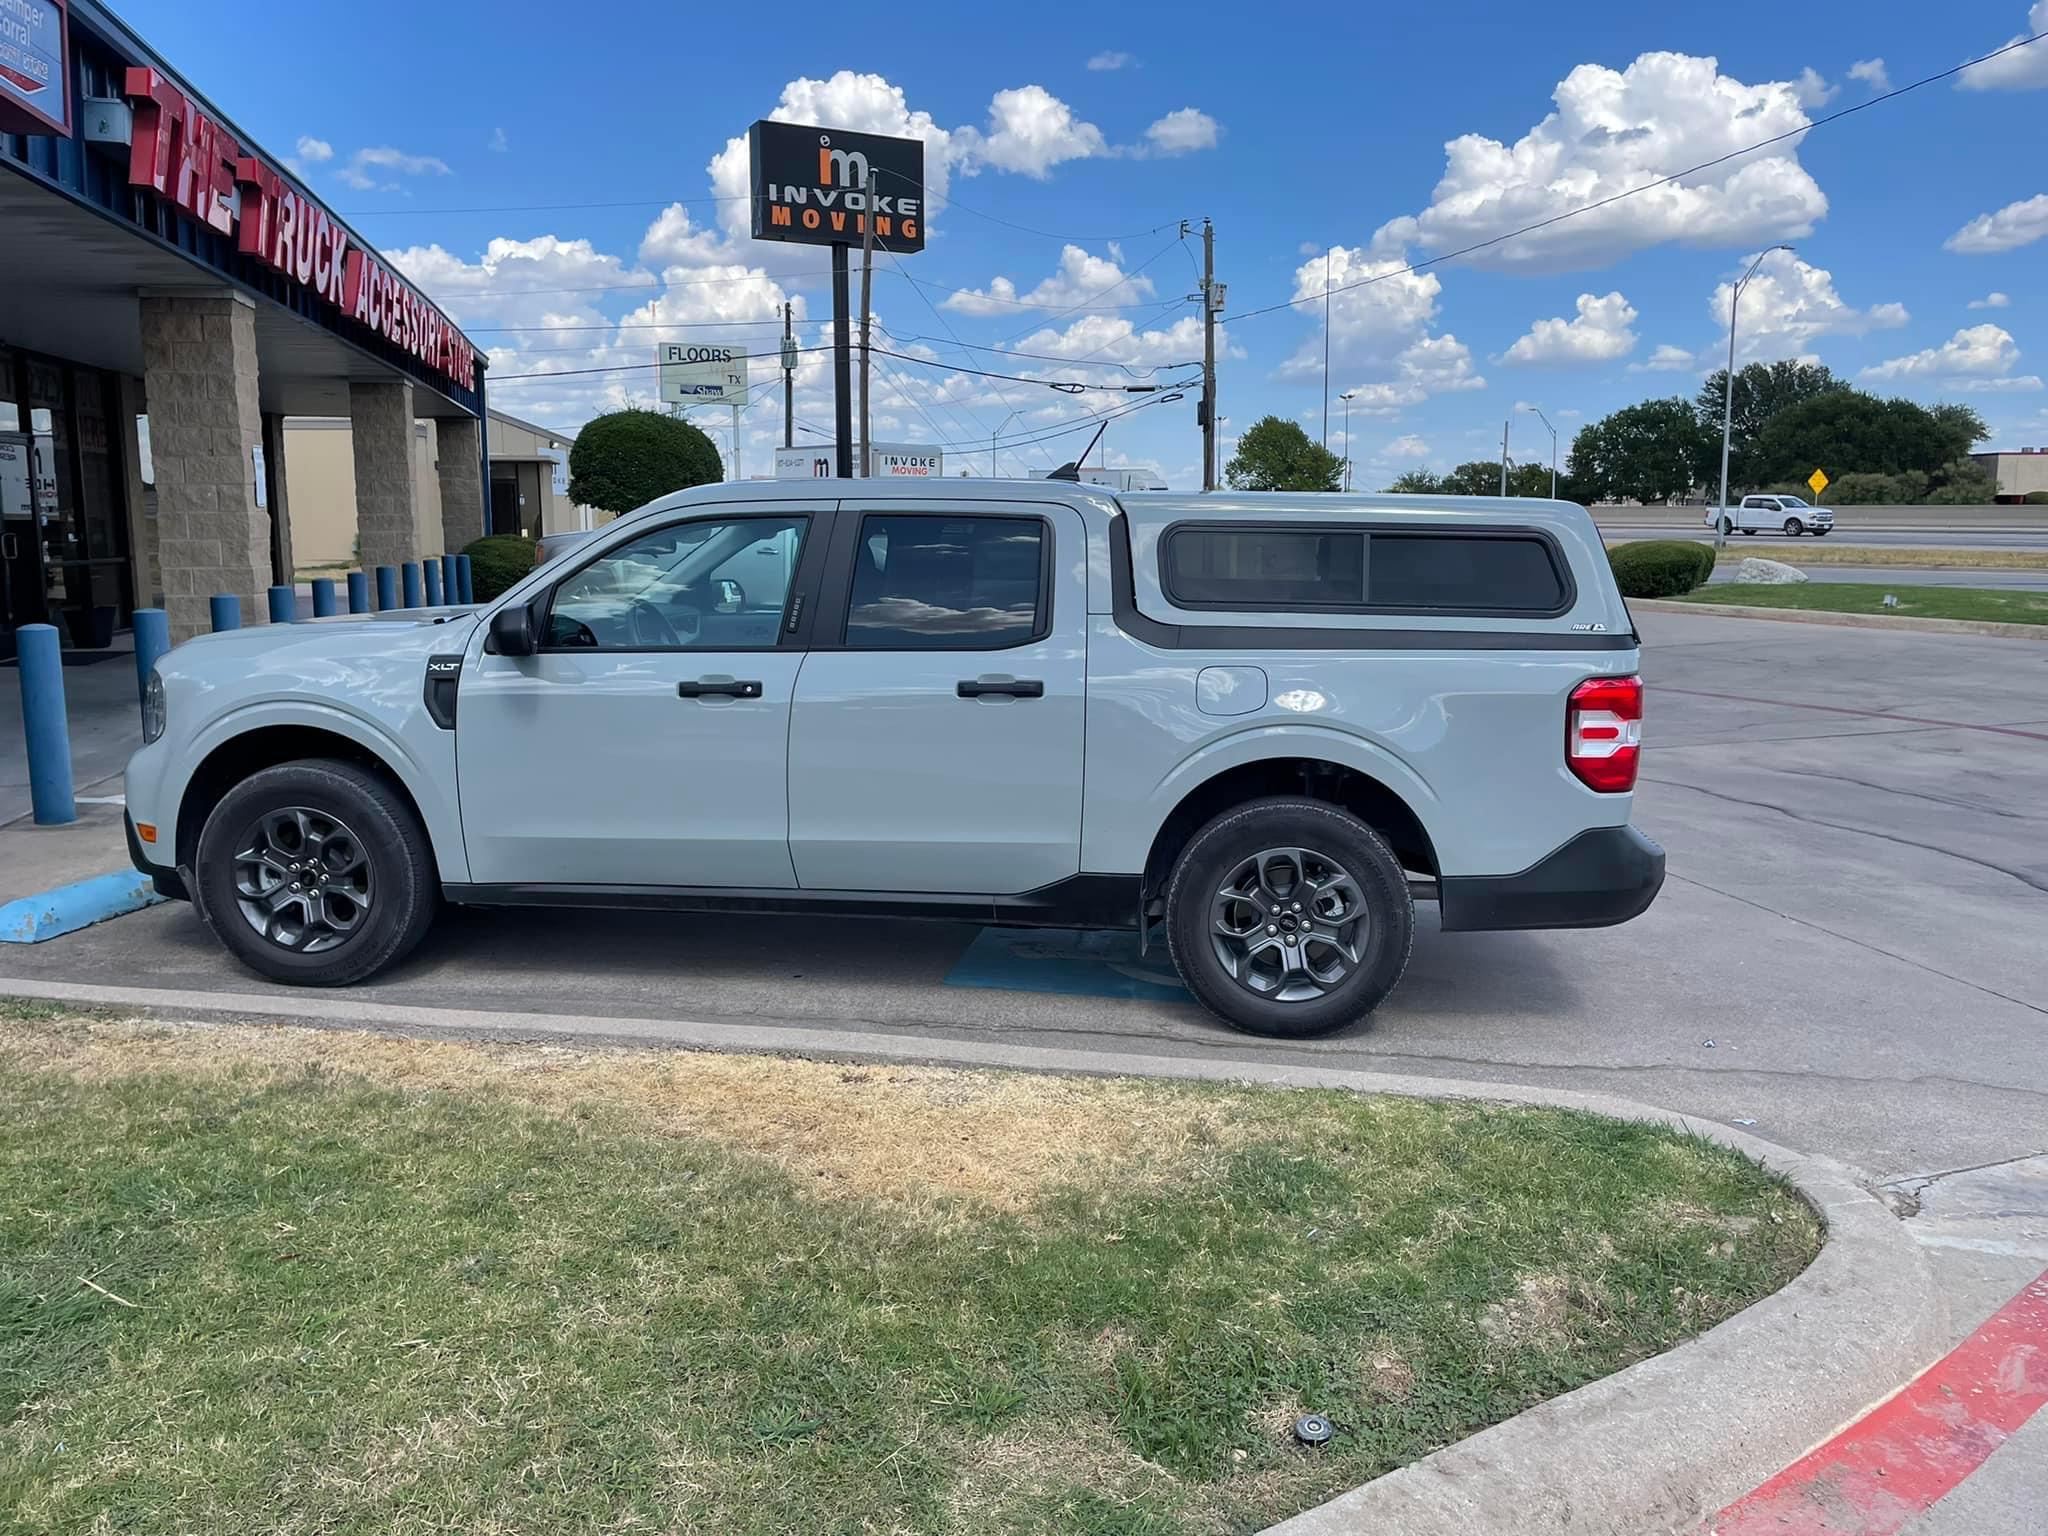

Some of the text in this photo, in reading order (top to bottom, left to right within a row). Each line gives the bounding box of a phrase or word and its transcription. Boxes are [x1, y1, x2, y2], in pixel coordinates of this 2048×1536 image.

[0, 0, 44, 28] amper
[0, 15, 30, 47] orral
[768, 183, 917, 216] INVOKE
[128, 67, 475, 393] THE TRUCK ACCESSORY STORE
[771, 205, 917, 239] MOVING
[668, 346, 732, 363] FLOORS
[727, 374, 742, 385] TX
[696, 384, 723, 396] Shaw
[884, 455, 936, 468] INVOKE
[891, 466, 928, 476] MOVING
[428, 663, 460, 671] XLT
